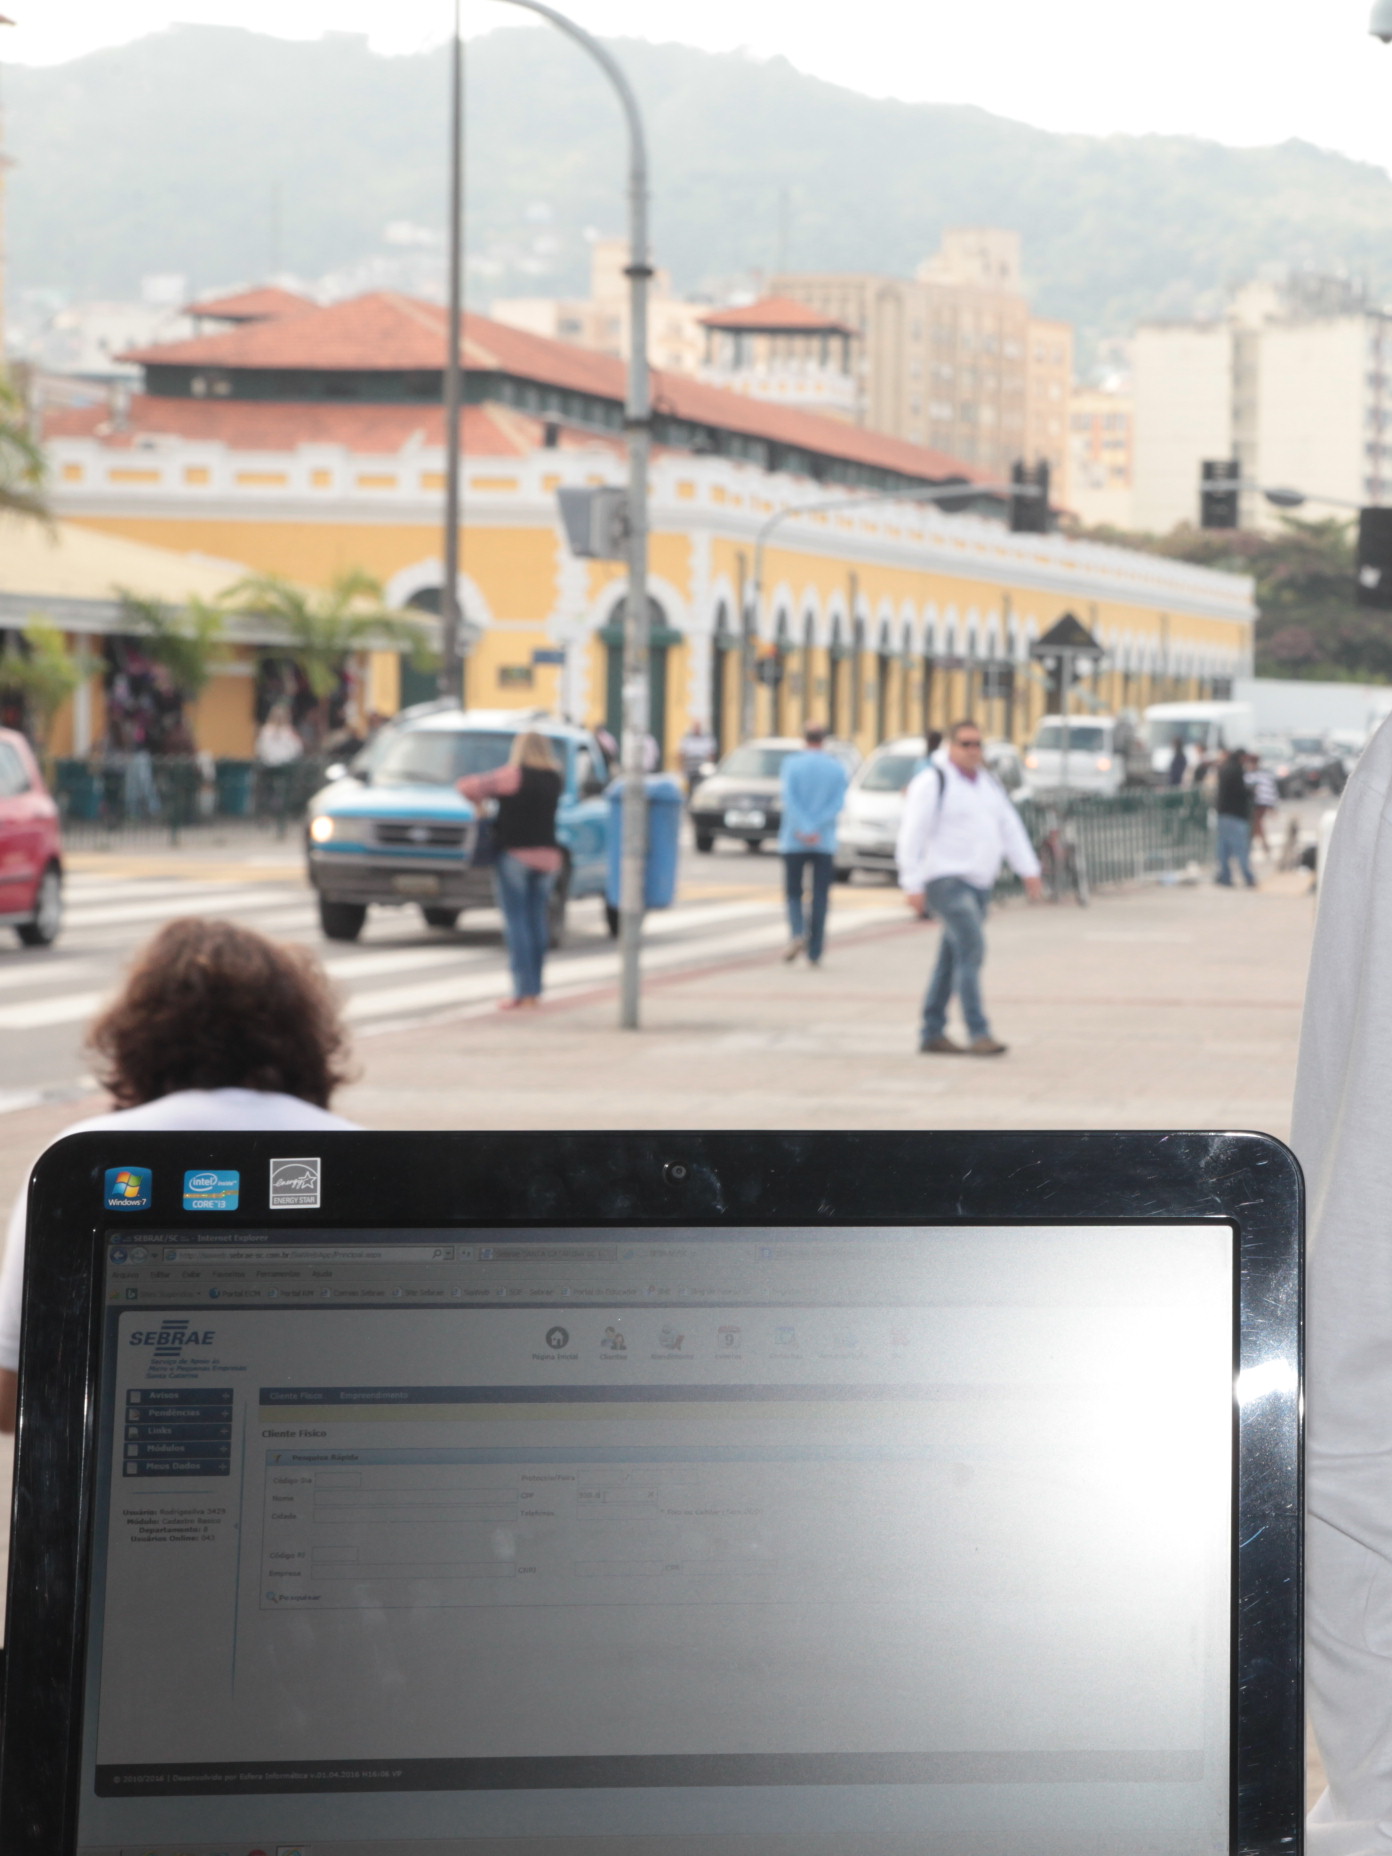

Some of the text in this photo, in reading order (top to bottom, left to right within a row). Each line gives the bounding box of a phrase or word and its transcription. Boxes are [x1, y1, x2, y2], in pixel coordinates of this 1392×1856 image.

[108, 1199, 141, 1207] Windows
[198, 1234, 232, 1242] Internet
[234, 1234, 268, 1243] Explorer
[129, 1331, 216, 1346] SEBRAE
[149, 1391, 180, 1399] Avisos
[148, 1426, 173, 1435] Links
[262, 1430, 297, 1438] Cliente
